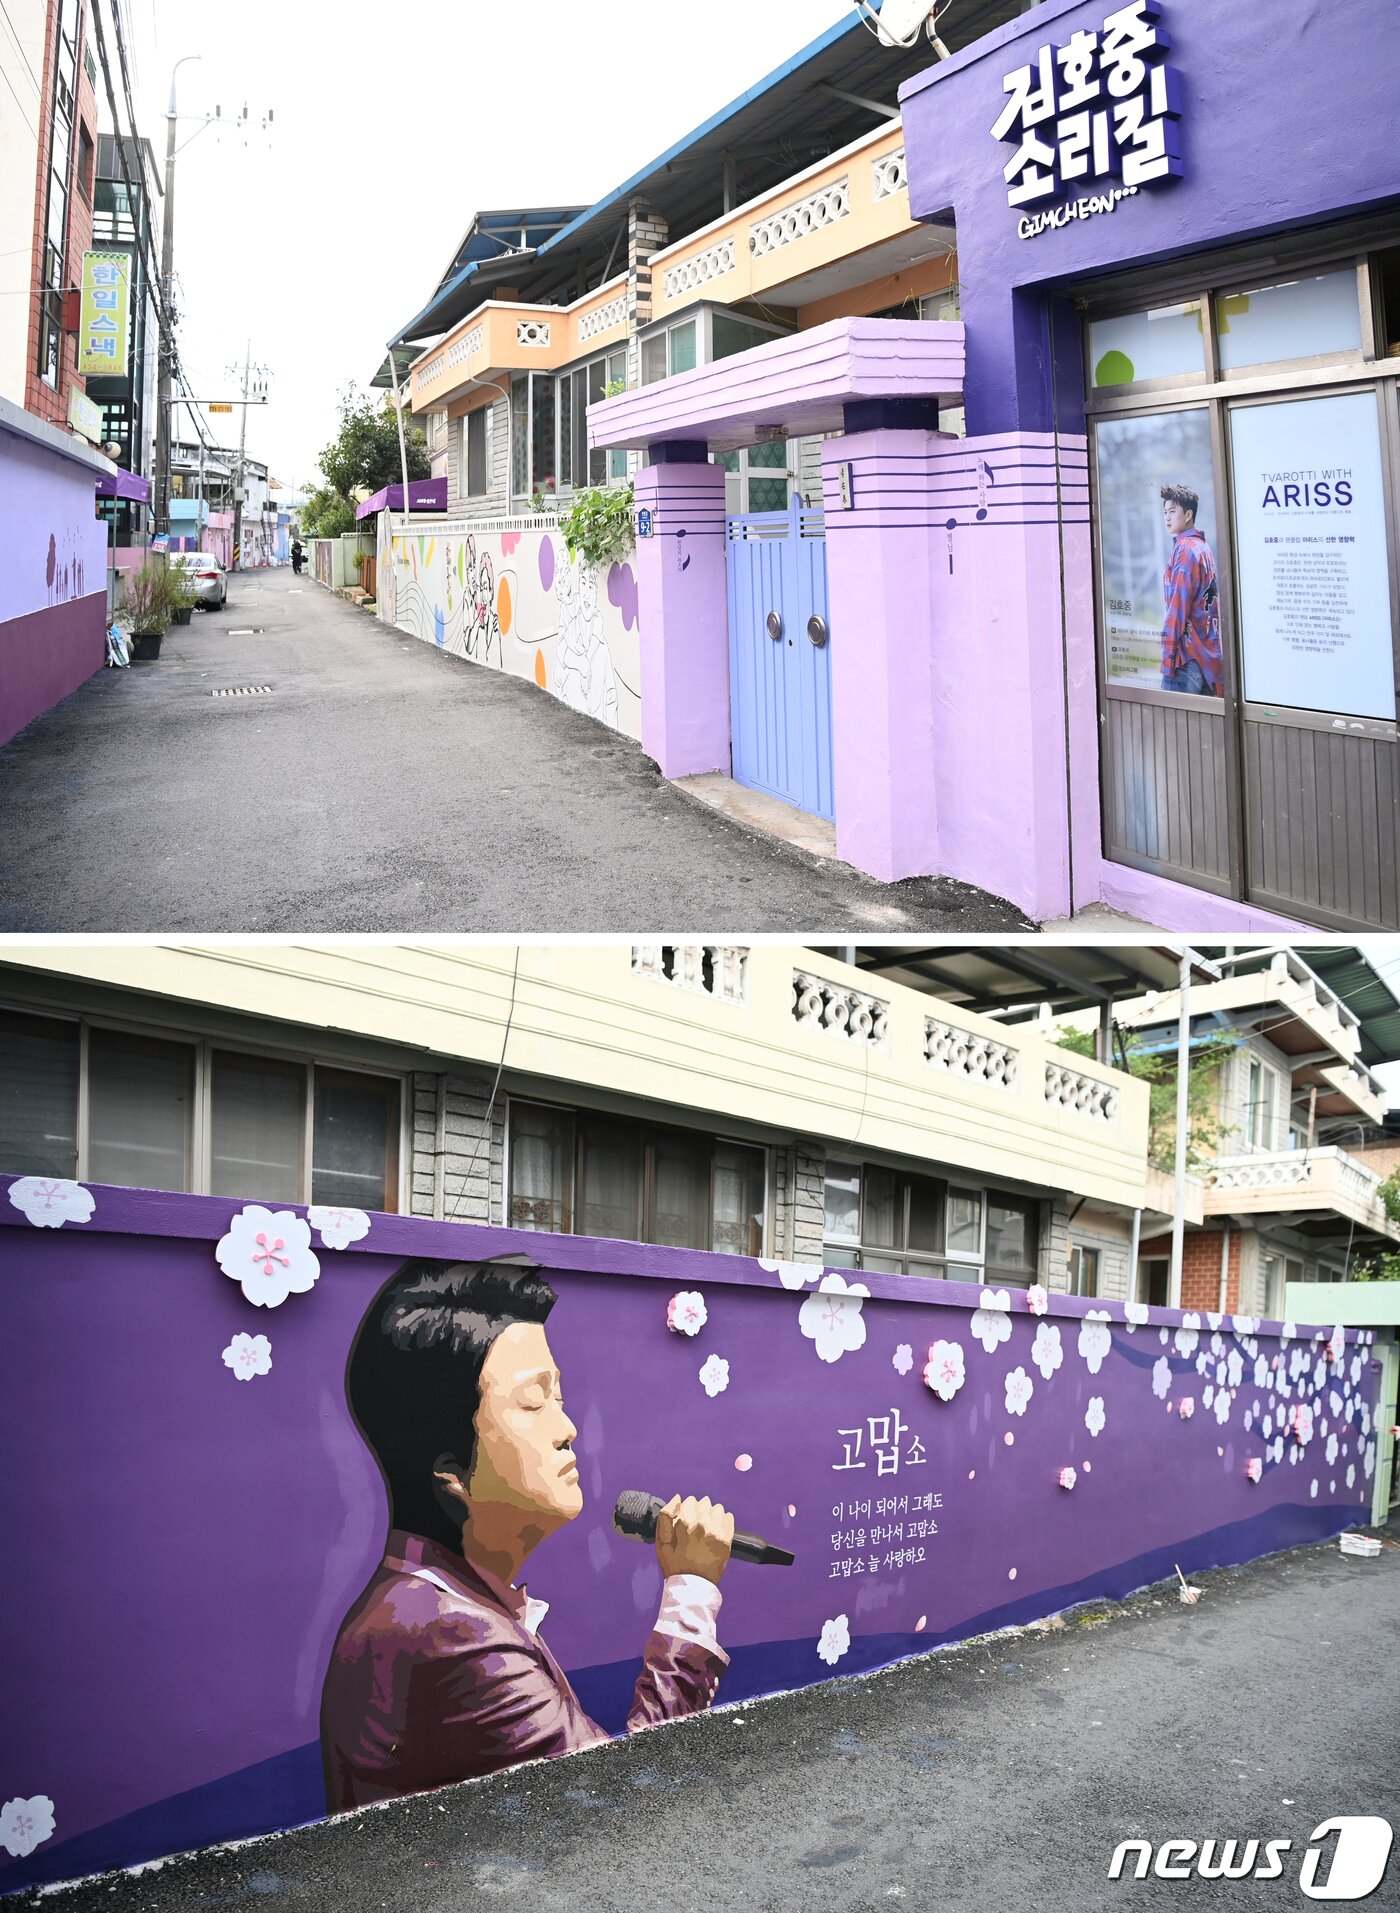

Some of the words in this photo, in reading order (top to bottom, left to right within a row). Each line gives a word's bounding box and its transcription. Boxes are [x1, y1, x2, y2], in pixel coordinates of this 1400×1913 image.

[989, 0, 1157, 141] 김호중
[1003, 64, 1169, 207] 소리길
[89, 265, 119, 358] 한일스낵
[1261, 470, 1317, 483] TVAROTTI
[1321, 468, 1352, 480] WITH
[1262, 480, 1353, 508] ARISS
[640, 521, 650, 533] 9-2
[1109, 599, 1131, 611] 김호중
[831, 1408, 927, 1477] 고맙소
[832, 1502, 844, 1522] 이
[849, 1499, 871, 1520] 나이
[876, 1495, 908, 1517] 되어서
[911, 1493, 944, 1511] 그래도
[831, 1528, 867, 1551] 당신을
[870, 1522, 903, 1545] 만나서
[906, 1519, 938, 1538] 고맙소
[829, 1557, 865, 1578] 고맙소
[867, 1554, 880, 1573] 늘
[883, 1547, 926, 1570] 사랑하오
